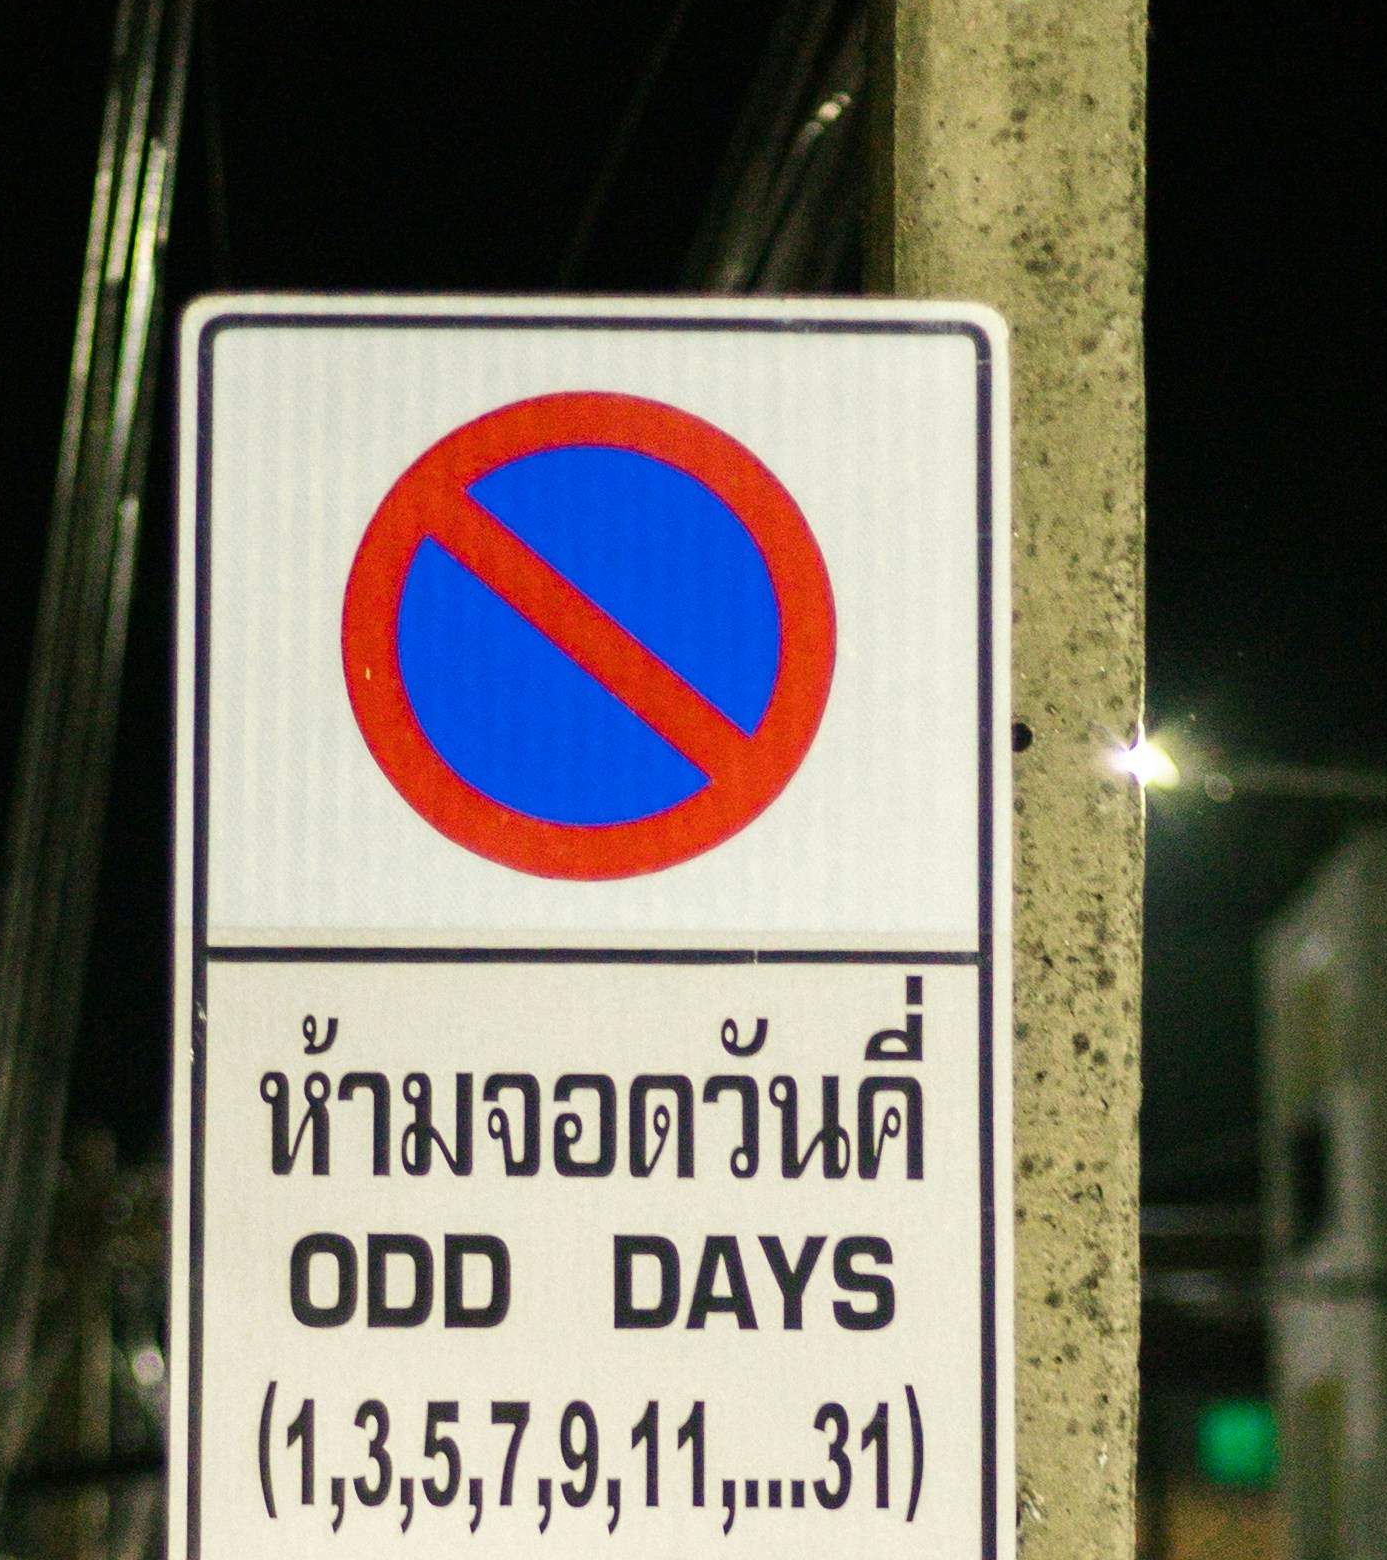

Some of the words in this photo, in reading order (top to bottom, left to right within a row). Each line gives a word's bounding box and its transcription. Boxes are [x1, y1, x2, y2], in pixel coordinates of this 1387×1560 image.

[259, 975, 924, 1181] ห้ามจอดวันคี่
[290, 1233, 510, 1329] ODD
[614, 1235, 896, 1332] DAYS
[258, 1380, 924, 1536] (1,3,5,7,9,11,...31)
